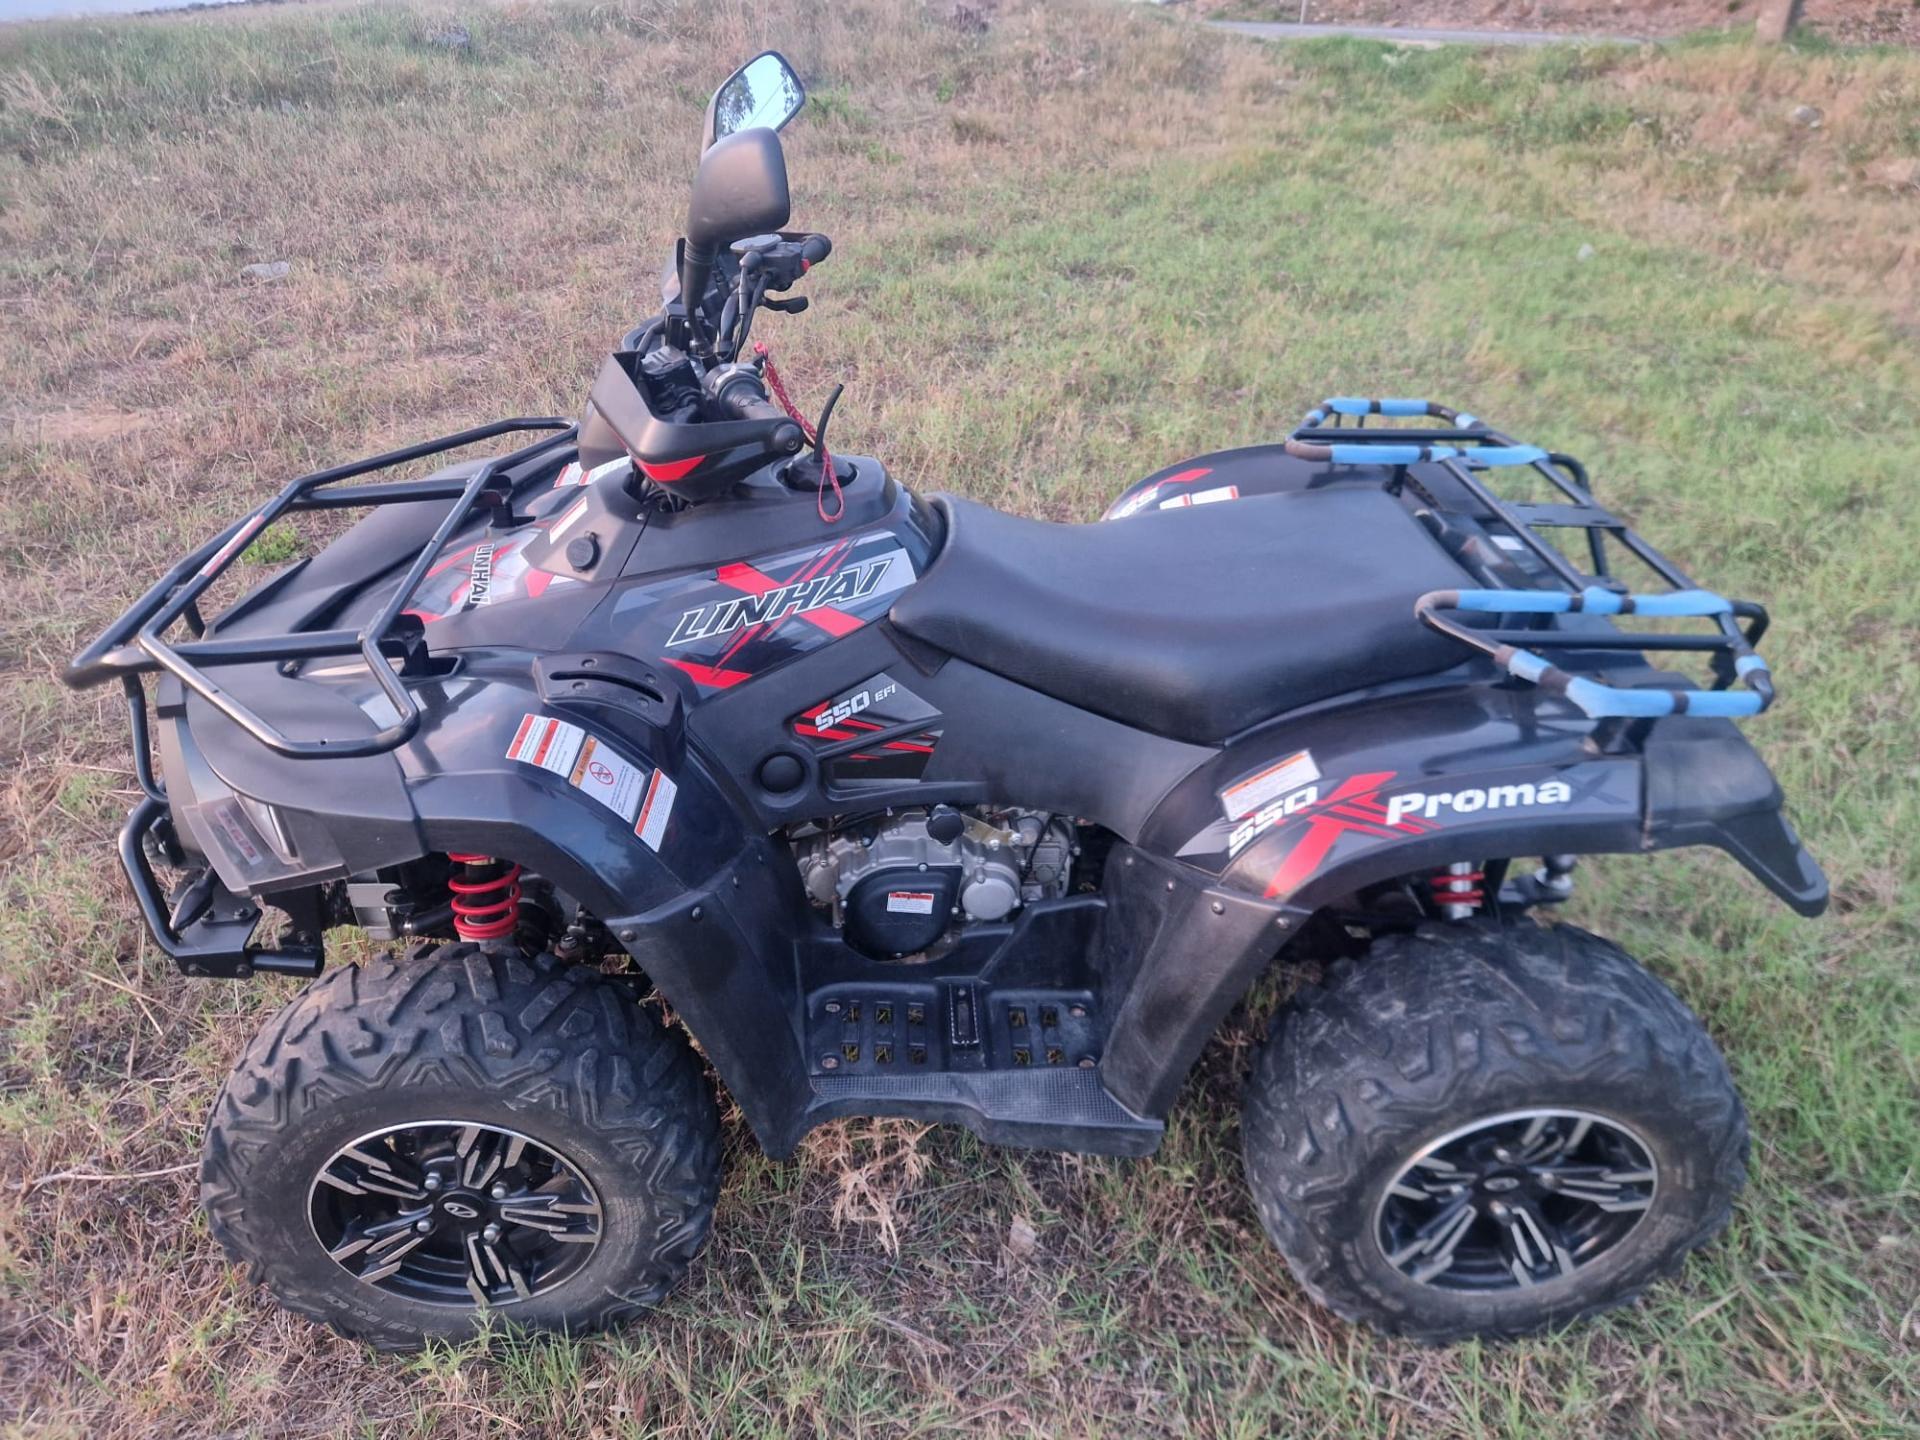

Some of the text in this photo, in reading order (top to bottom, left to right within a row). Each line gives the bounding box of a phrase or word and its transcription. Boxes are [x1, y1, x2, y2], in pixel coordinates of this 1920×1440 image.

[470, 544, 494, 604] LINHAI
[664, 558, 893, 648] LINHAI
[815, 684, 896, 733] 550 EFI
[1229, 786, 1318, 859] 550
[1385, 781, 1571, 826] Proma
